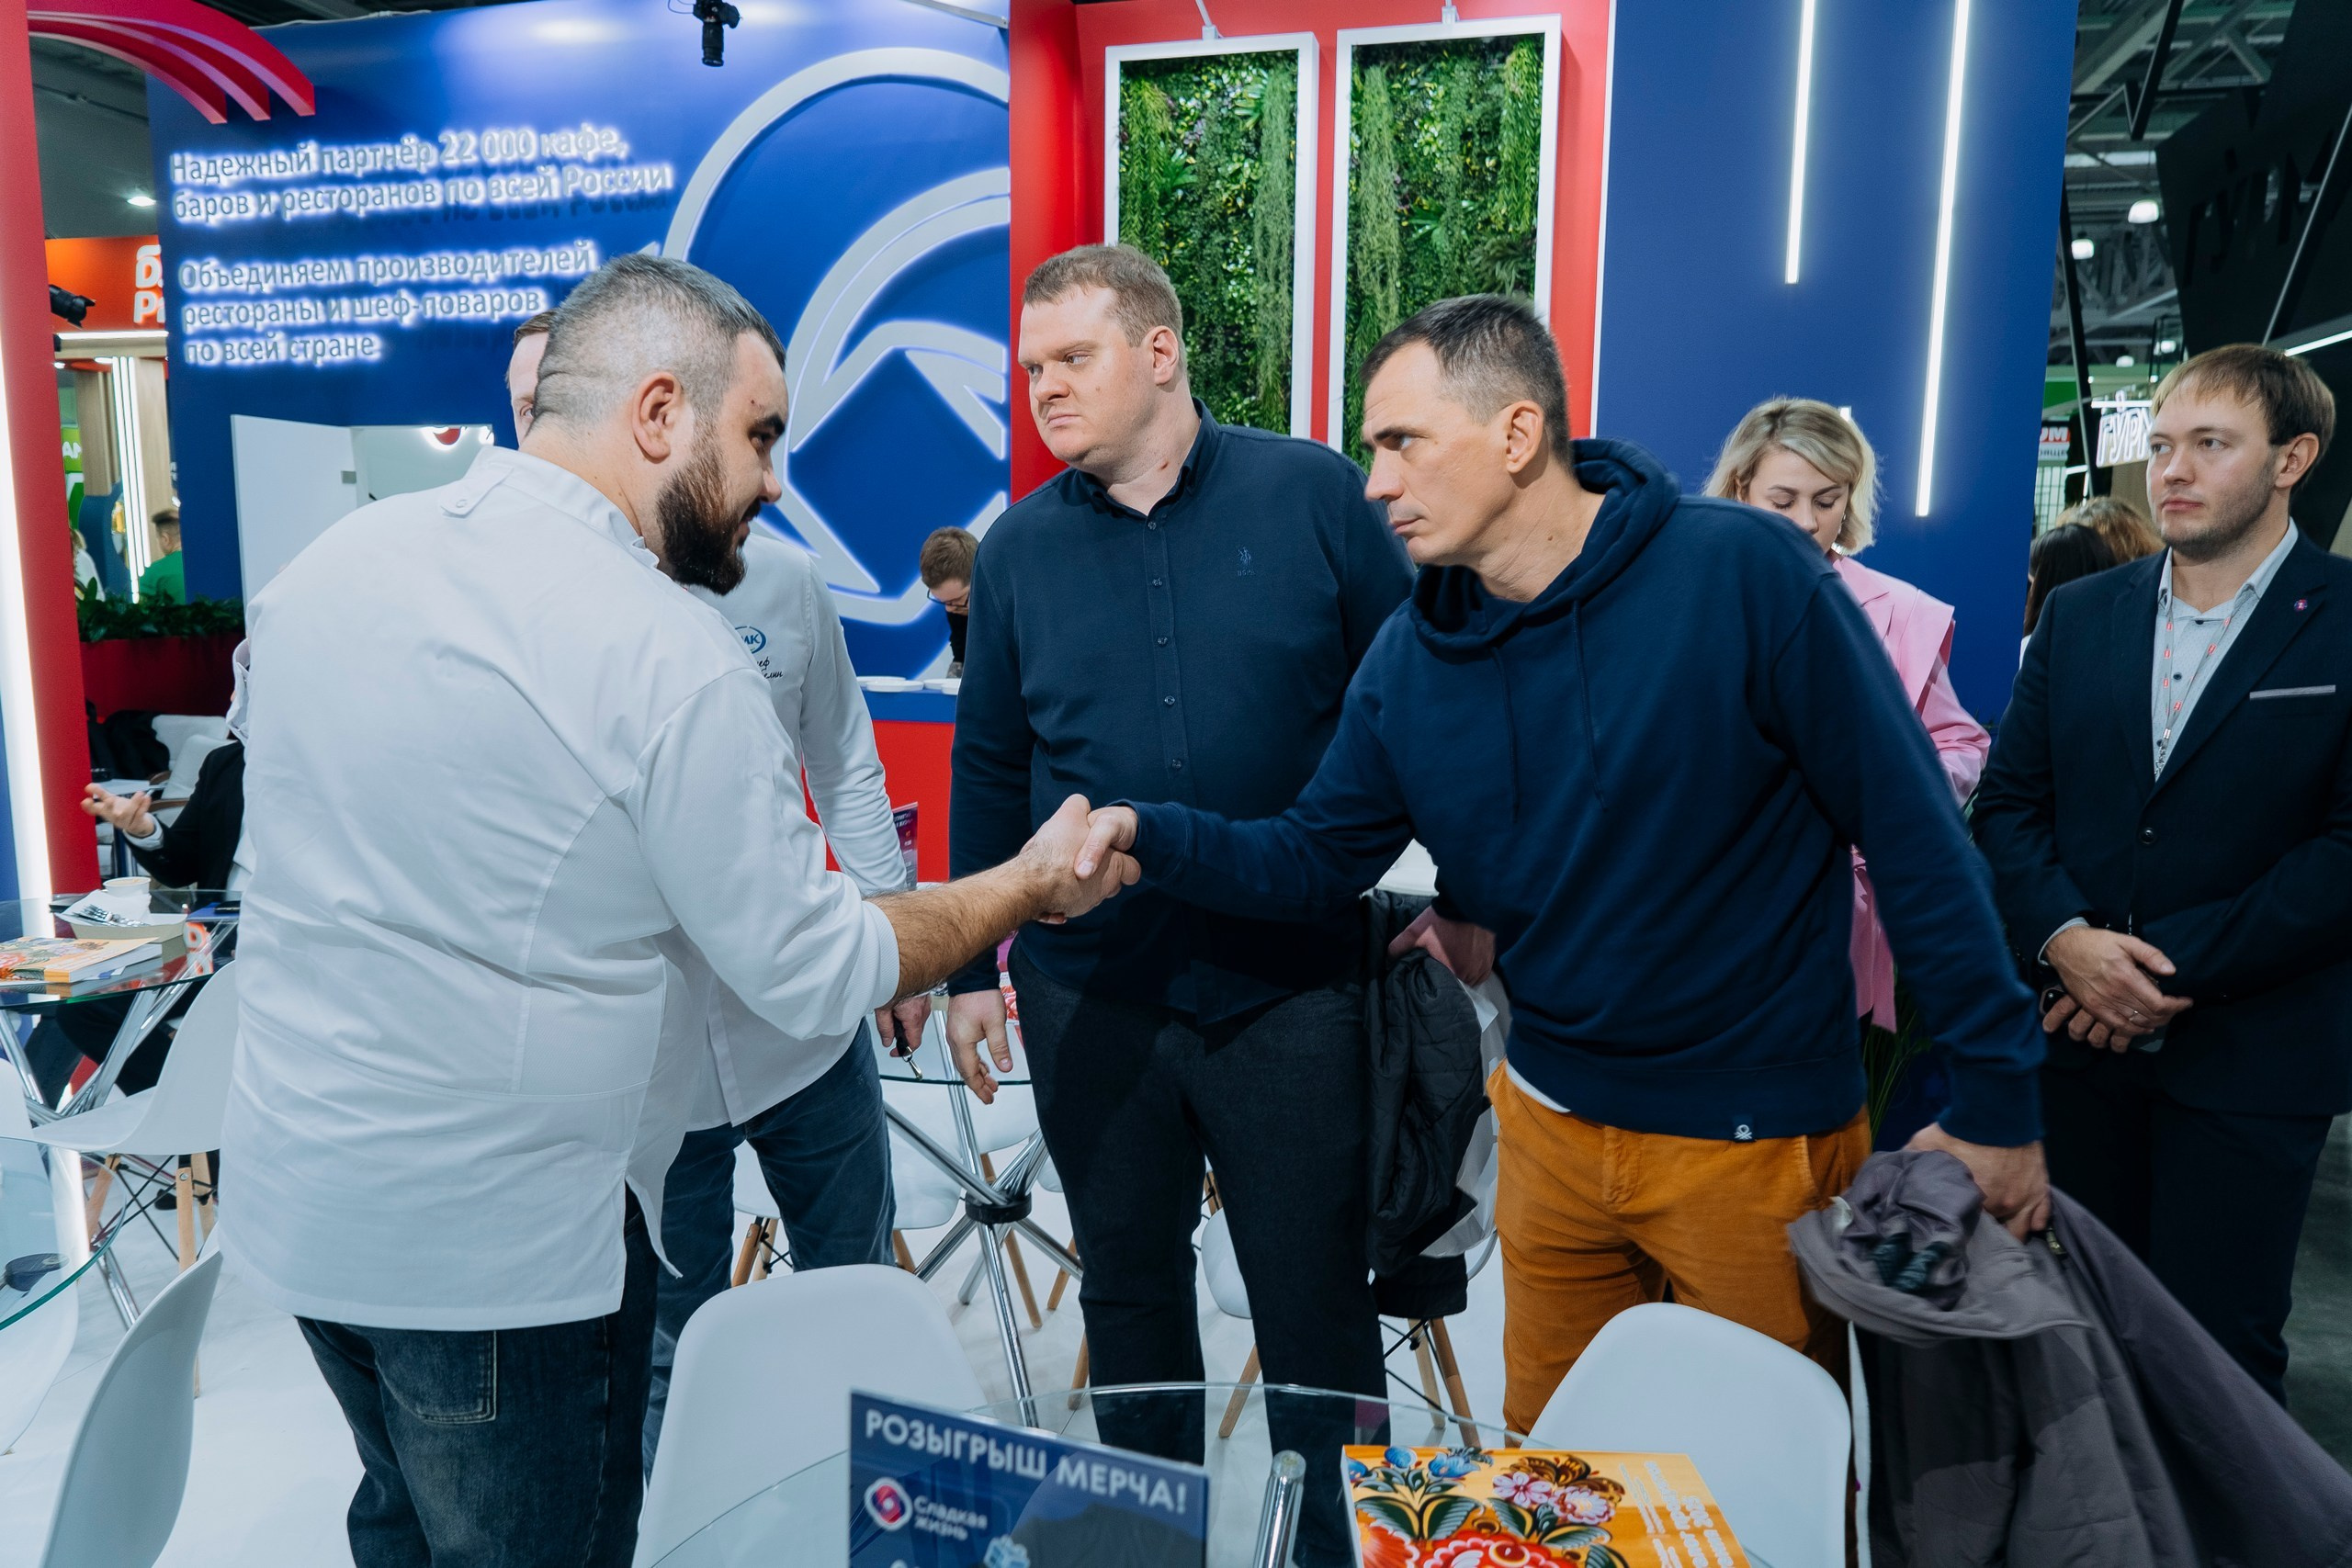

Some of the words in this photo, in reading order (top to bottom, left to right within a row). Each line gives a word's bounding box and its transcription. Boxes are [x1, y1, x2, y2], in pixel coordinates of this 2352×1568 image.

[170, 141, 315, 185] Надежный
[322, 135, 435, 175] партнёр
[438, 131, 477, 164] 22
[481, 128, 535, 162] 000
[540, 123, 628, 160] кафе,
[173, 189, 252, 223] баров
[257, 193, 275, 215] и
[282, 182, 437, 220] ресторанов
[446, 179, 481, 204] по
[488, 165, 555, 202] всей
[561, 165, 672, 196] России
[179, 258, 349, 292] Объединяем
[356, 240, 594, 287] производителей
[183, 299, 322, 333] рестораны
[328, 298, 345, 321] и
[353, 289, 544, 323] шеф-поваров
[185, 341, 217, 364] по
[223, 331, 282, 362] всей
[288, 335, 378, 366] стране
[865, 1408, 1047, 1480] РОЗЫГРЫШ
[1056, 1456, 1187, 1514] МЕРЧА!
[913, 1495, 989, 1529] Сладкая
